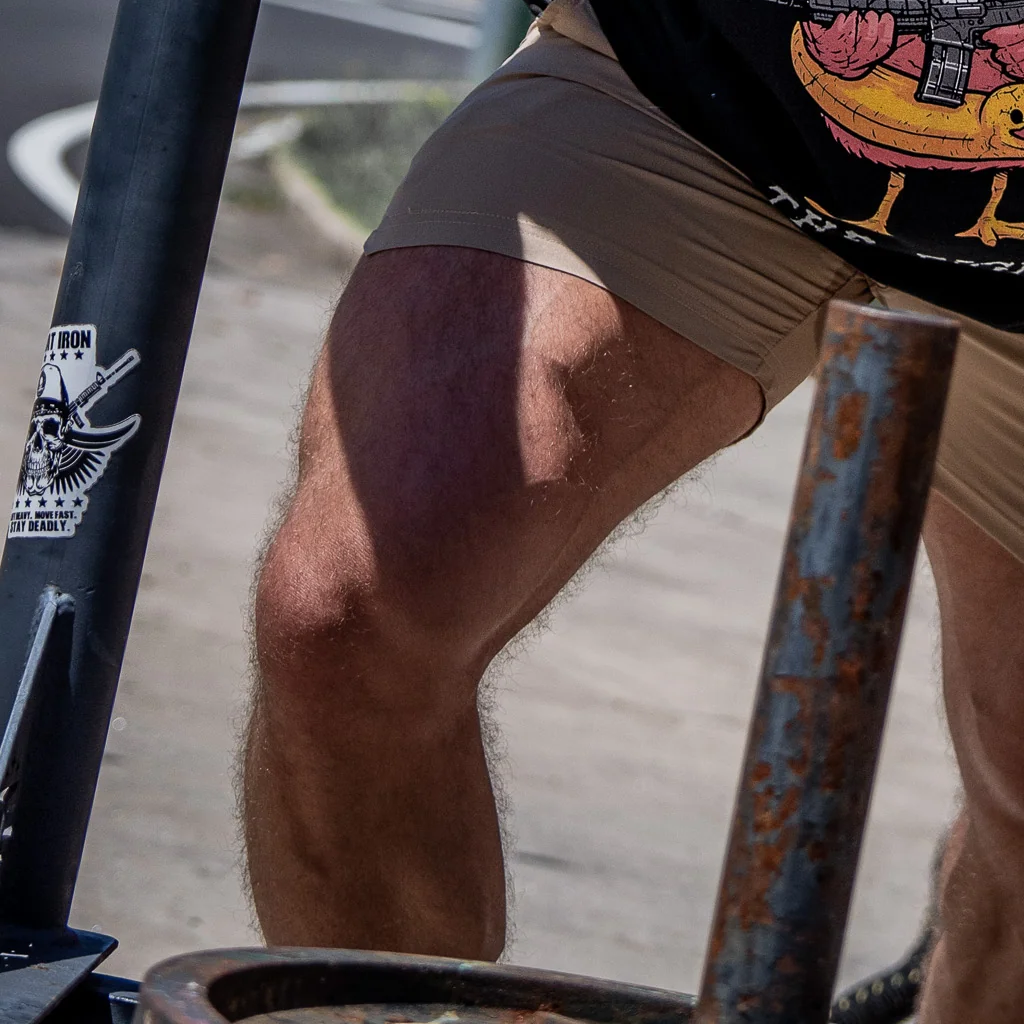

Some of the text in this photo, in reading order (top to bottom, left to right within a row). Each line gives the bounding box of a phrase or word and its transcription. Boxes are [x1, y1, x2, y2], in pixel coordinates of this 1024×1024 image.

[57, 329, 92, 349] IRON
[34, 510, 54, 519] MOVE
[54, 510, 77, 519] FAST.
[9, 519, 71, 533] STAY DEADLY.
